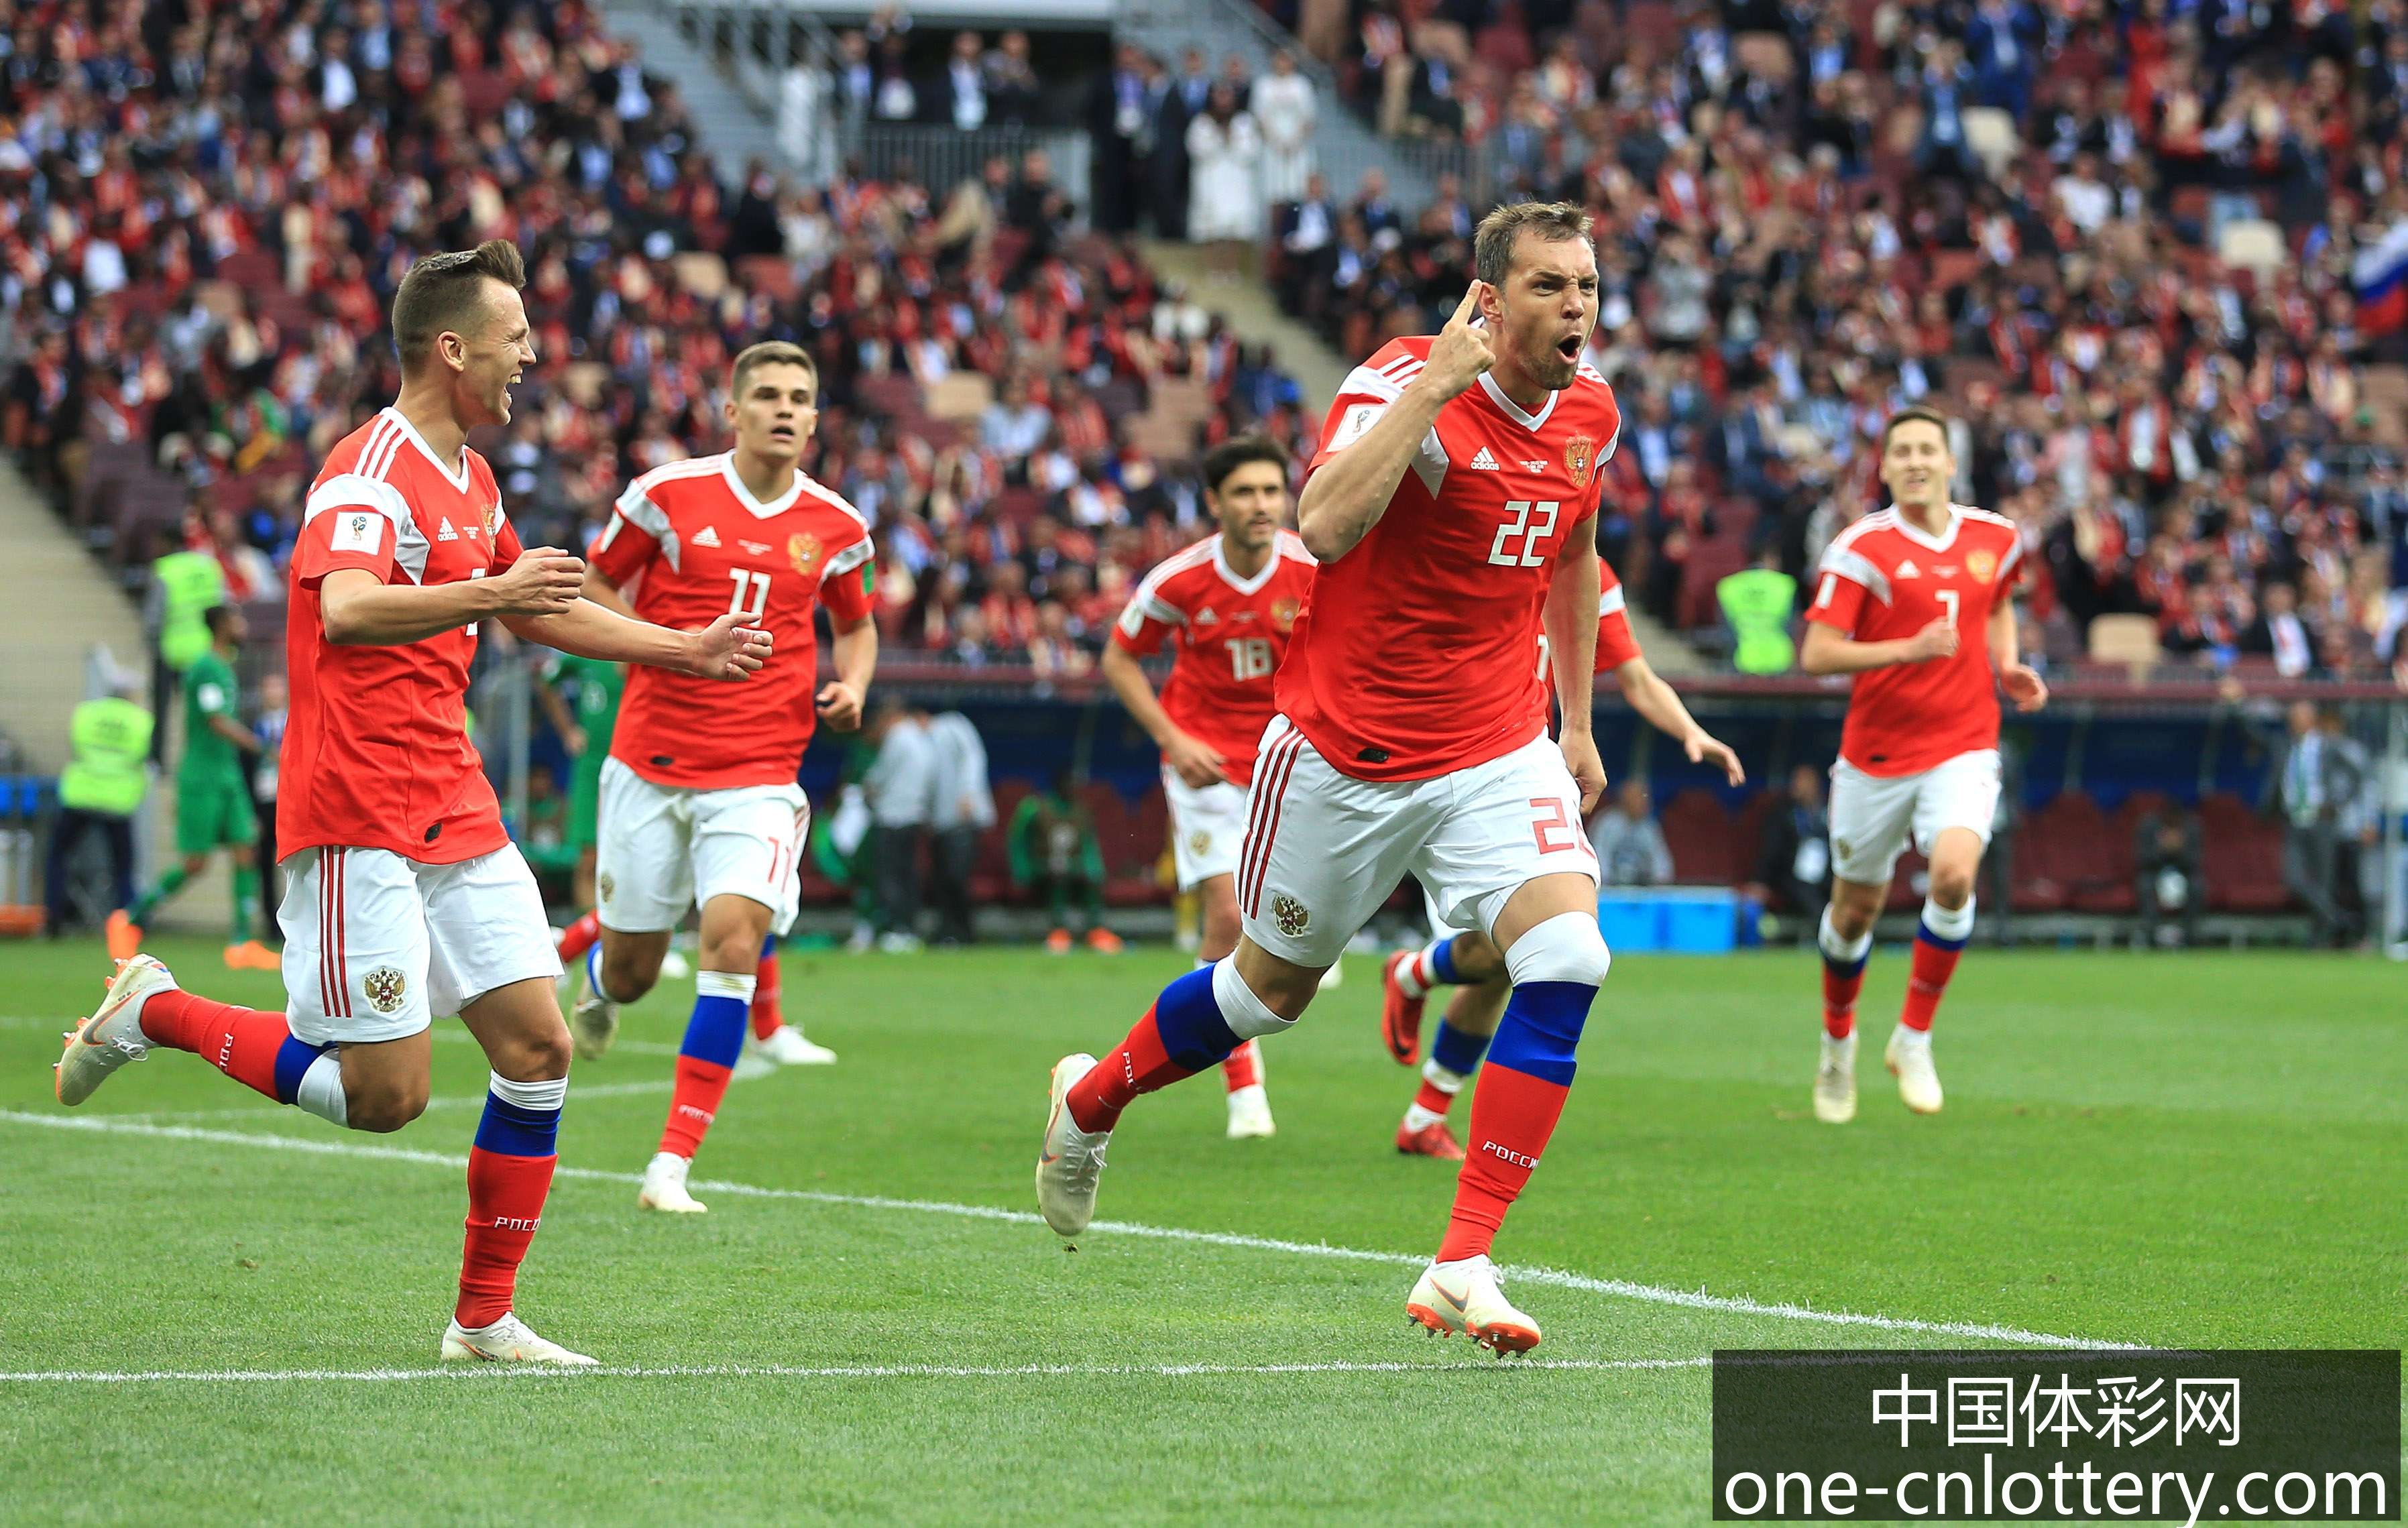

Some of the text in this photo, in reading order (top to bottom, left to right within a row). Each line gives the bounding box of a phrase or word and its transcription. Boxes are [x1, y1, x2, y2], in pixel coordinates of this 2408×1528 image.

[1470, 461, 1500, 471] adidas
[1488, 501, 1560, 567] 22
[729, 567, 772, 628] 11
[1224, 638, 1272, 681] 18
